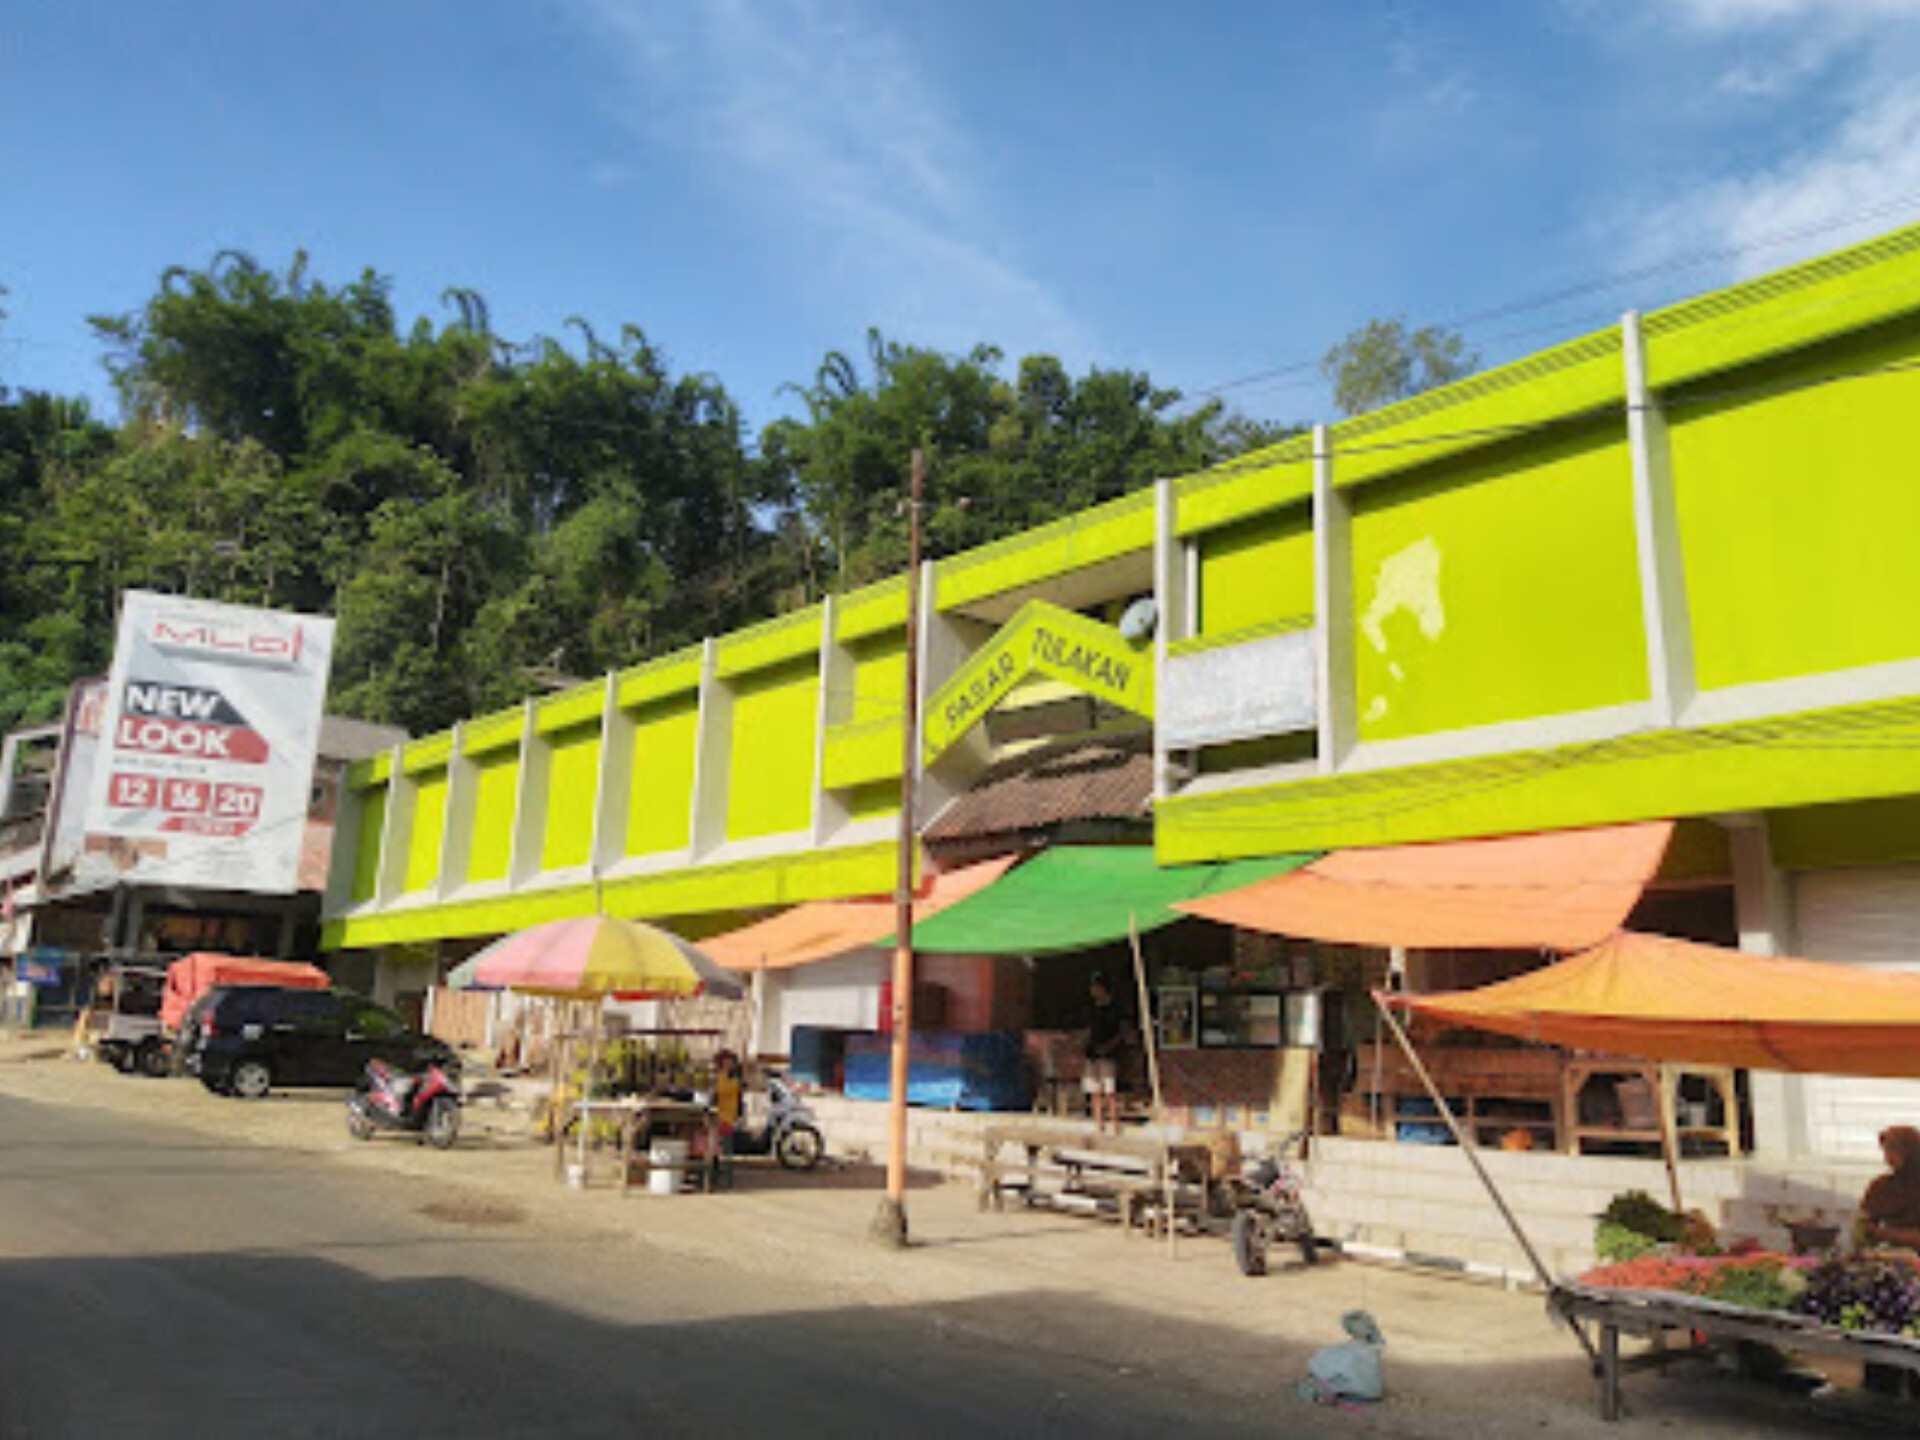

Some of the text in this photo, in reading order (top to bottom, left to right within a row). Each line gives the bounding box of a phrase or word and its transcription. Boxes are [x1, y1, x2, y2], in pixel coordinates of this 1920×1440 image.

[945, 628, 1130, 729] PASAR TULAKAN
[127, 686, 217, 717] NEW
[121, 720, 230, 755] LOOK
[117, 778, 149, 804] 12
[218, 788, 254, 813] 20
